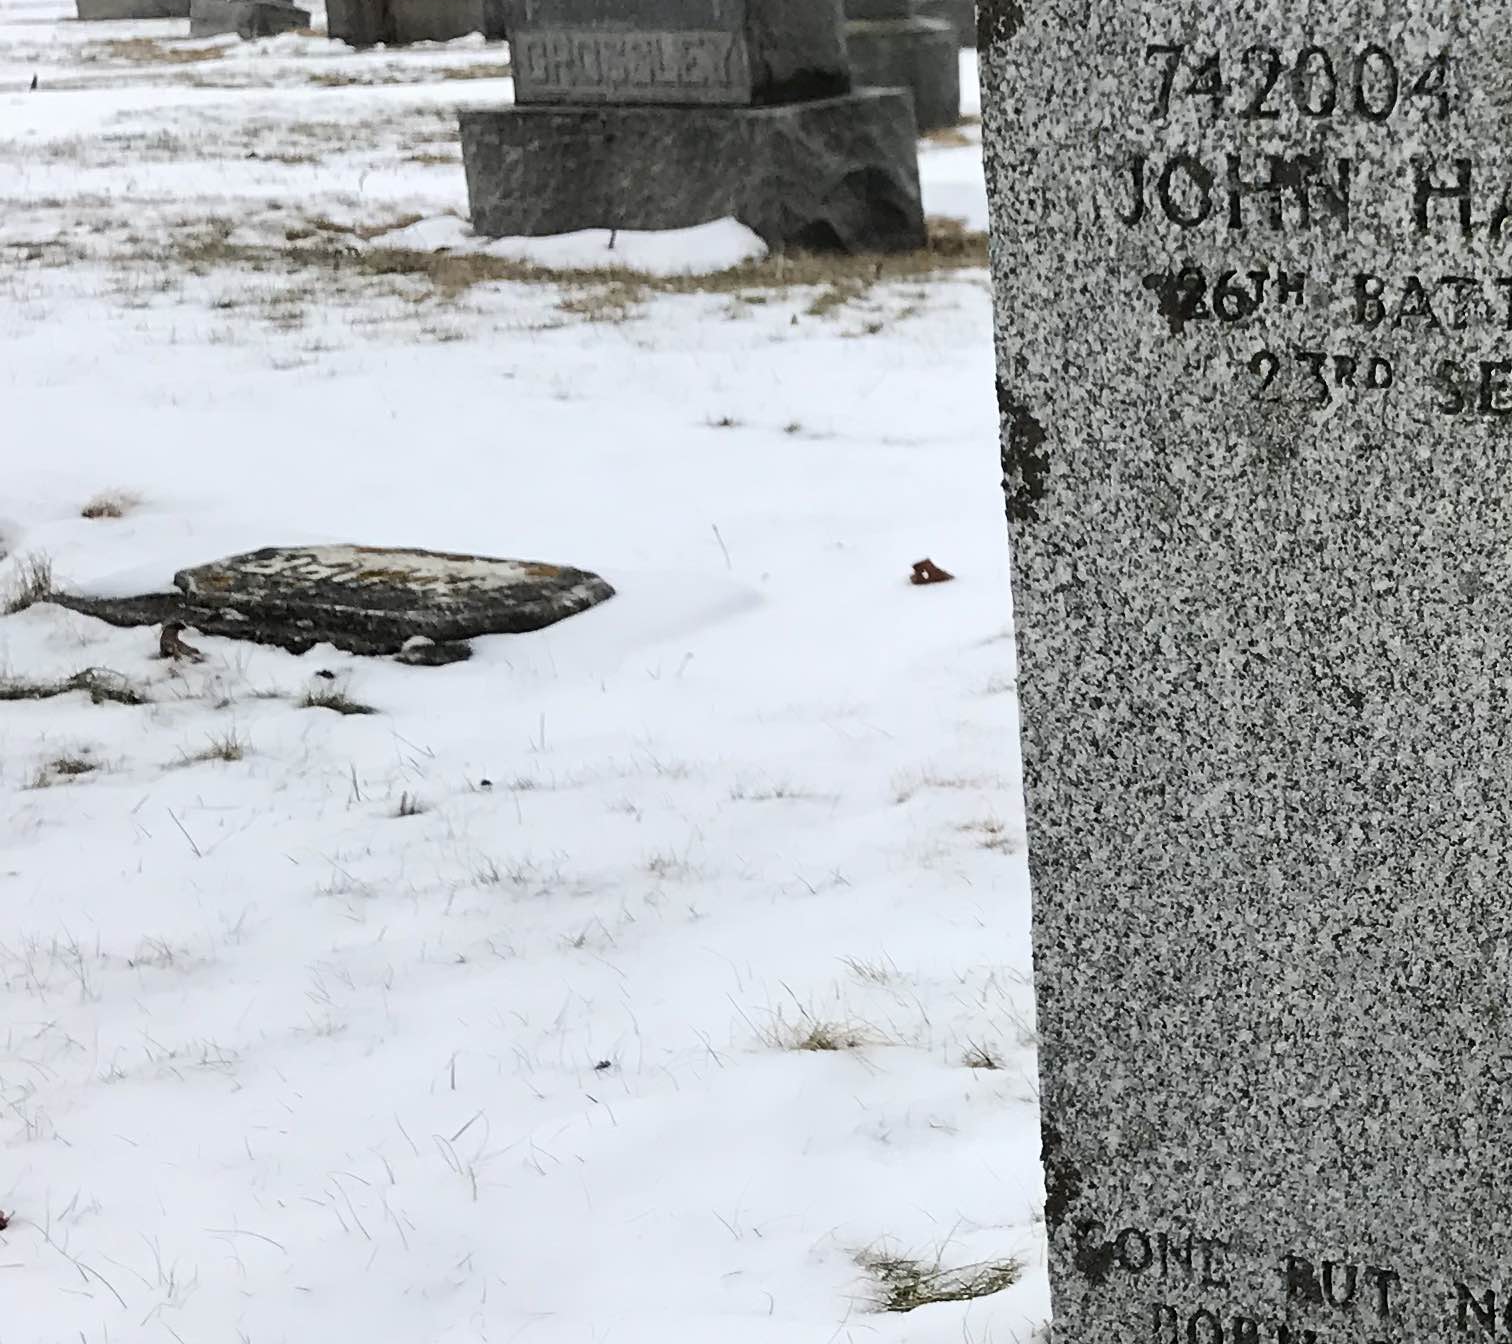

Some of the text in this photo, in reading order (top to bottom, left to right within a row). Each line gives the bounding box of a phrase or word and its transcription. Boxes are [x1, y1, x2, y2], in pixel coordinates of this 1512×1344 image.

[1146, 43, 1451, 122] 742004
[1118, 154, 1351, 235] JOHN
[1176, 266, 1305, 324] 26TH
[1246, 351, 1394, 408] 23RD
[1285, 1254, 1400, 1320] BUT
